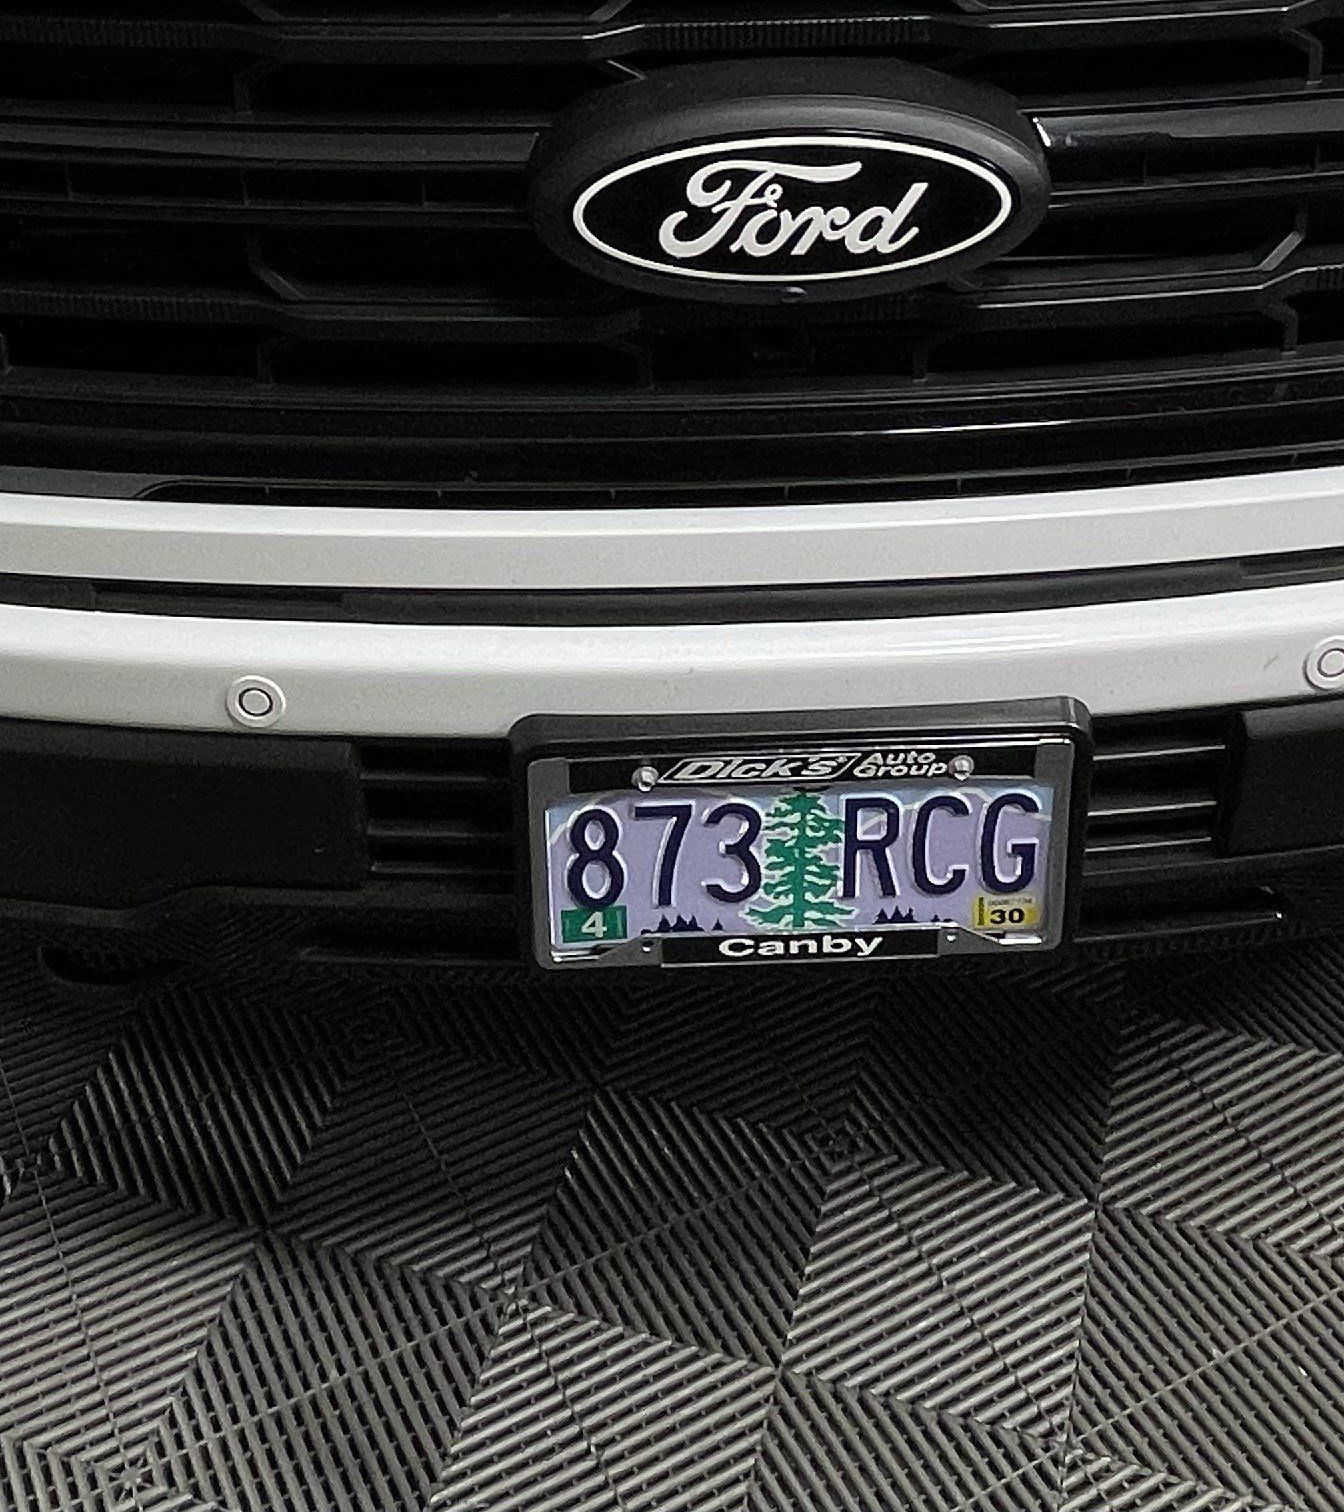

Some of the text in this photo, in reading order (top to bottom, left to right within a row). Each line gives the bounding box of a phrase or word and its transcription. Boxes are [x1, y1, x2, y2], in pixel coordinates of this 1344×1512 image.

[658, 160, 929, 258] Ford
[860, 751, 936, 766] Auto
[853, 762, 948, 778] Group
[566, 791, 1042, 909] 873 RCG
[580, 910, 608, 938] 4
[989, 908, 1026, 925] 30
[718, 935, 884, 957] Canby
